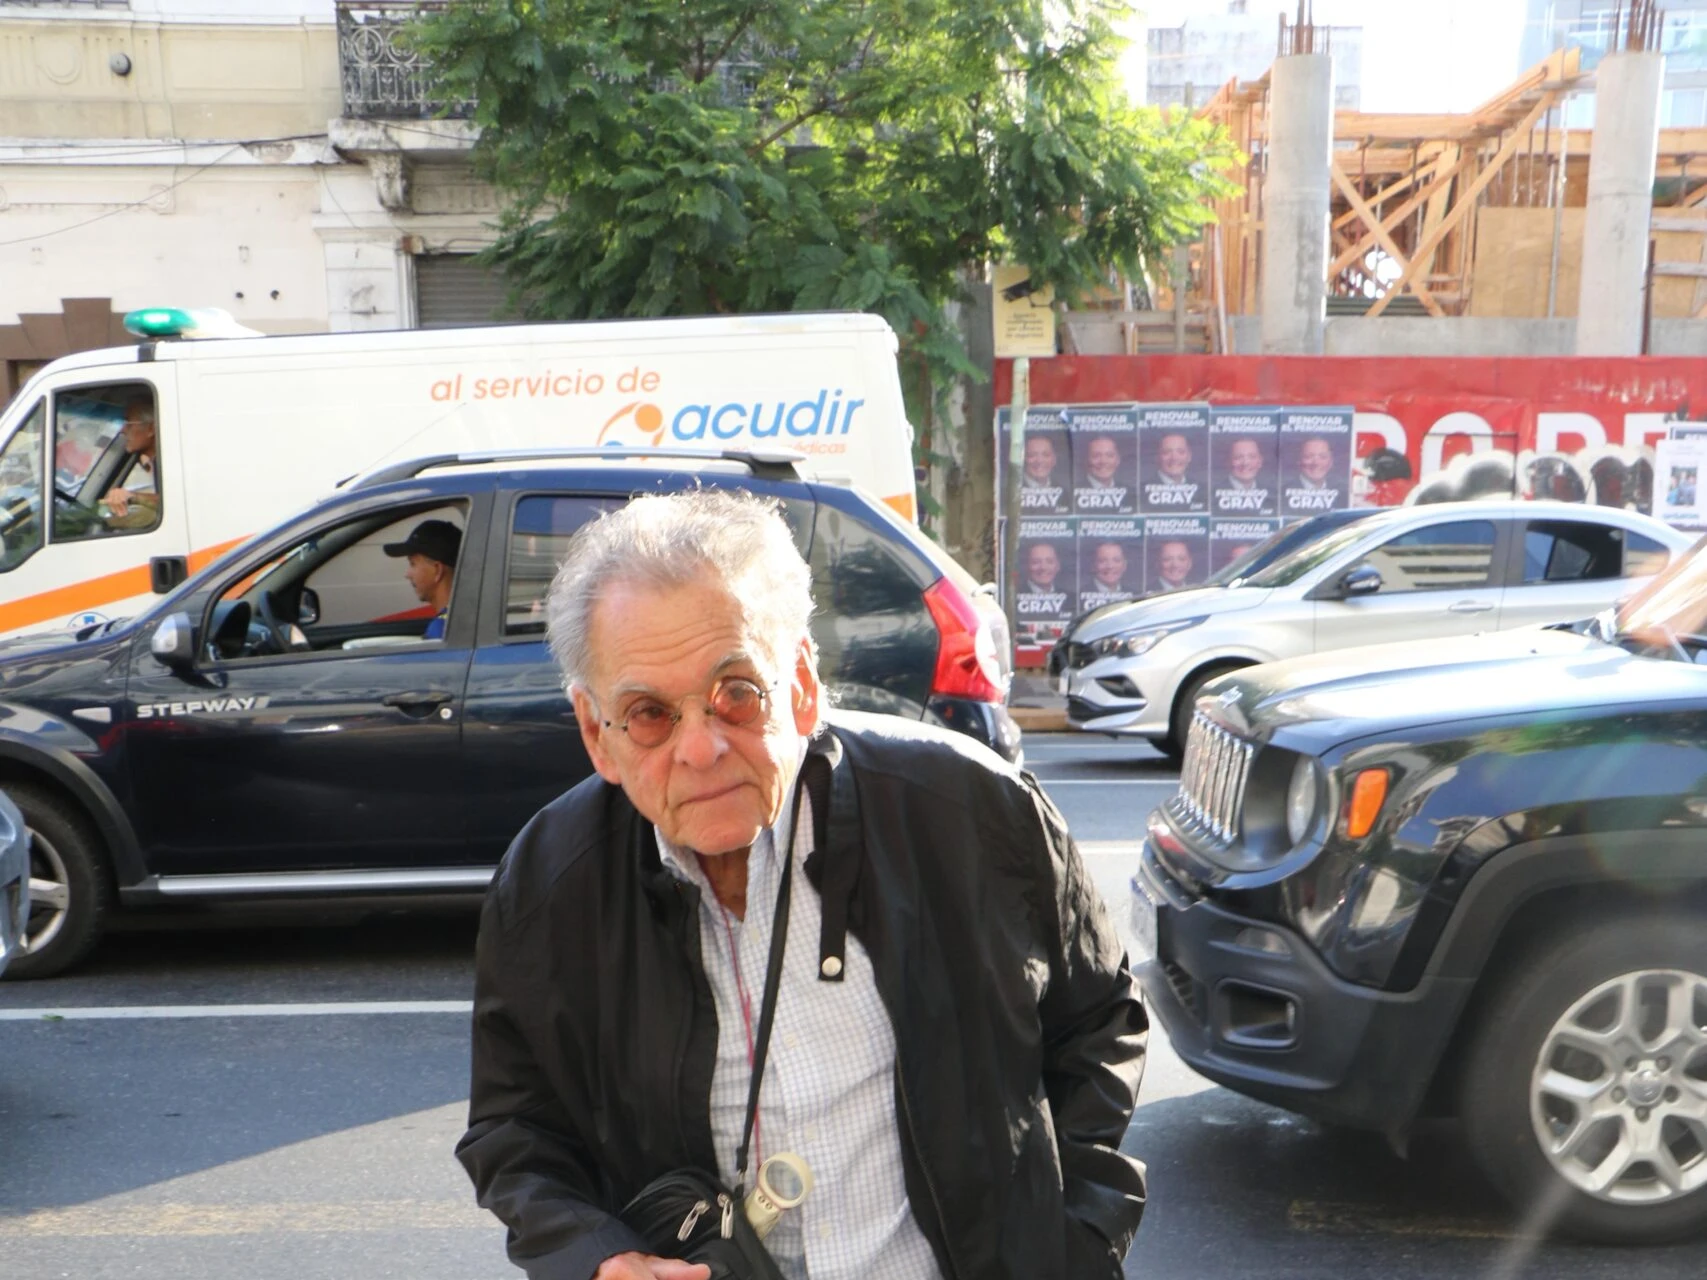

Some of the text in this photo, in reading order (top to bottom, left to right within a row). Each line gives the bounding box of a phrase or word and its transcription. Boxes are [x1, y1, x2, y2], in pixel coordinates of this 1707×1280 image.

[430, 366, 661, 401] al servicio de
[671, 389, 865, 441] acudir
[1145, 411, 1199, 420] RENOVAR
[1216, 416, 1271, 425] RENOVAR
[1288, 415, 1343, 425] RENOVAR
[1077, 494, 1125, 508] GRAY
[1148, 490, 1196, 504] GRAY
[1219, 495, 1265, 509] GRAY
[1289, 494, 1336, 508] GRAY
[1017, 600, 1064, 613] GRAY
[136, 697, 255, 719] STEPWAY
